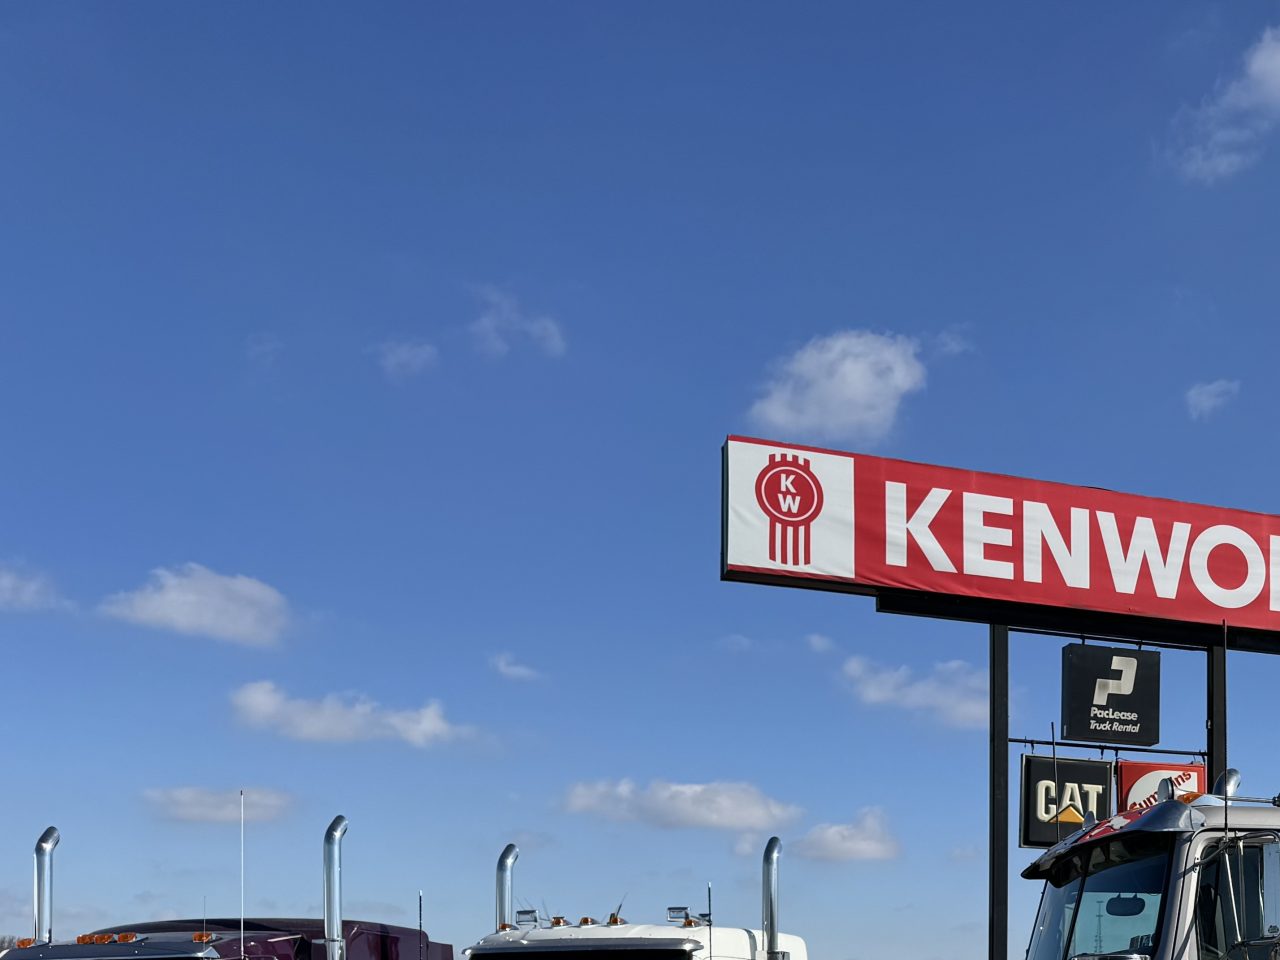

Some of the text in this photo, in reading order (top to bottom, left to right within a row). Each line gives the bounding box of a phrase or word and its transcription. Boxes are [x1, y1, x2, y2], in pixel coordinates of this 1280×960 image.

[1090, 706, 1139, 721] PacLease
[1089, 720, 1141, 733] Truck Rental
[1036, 779, 1103, 823] CAT
